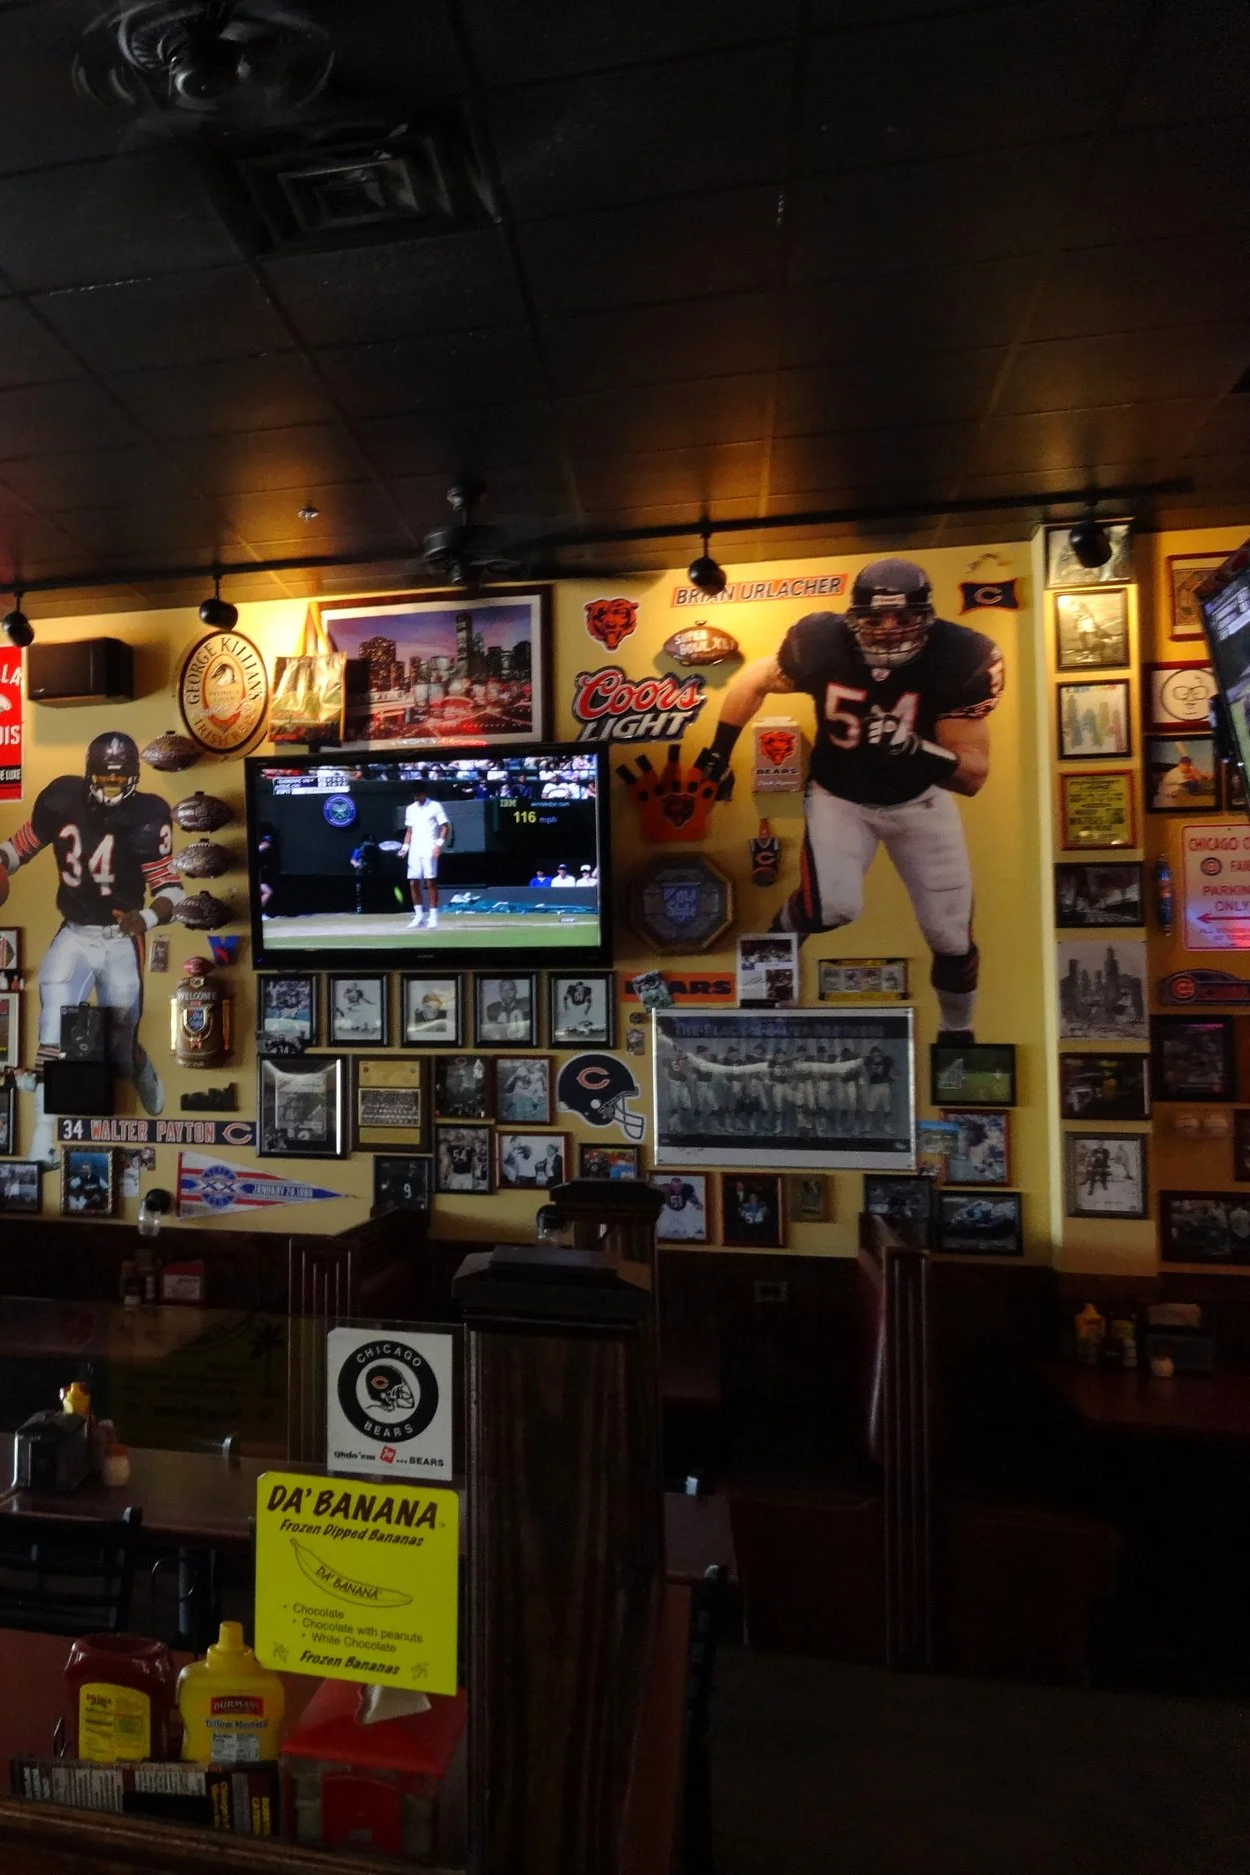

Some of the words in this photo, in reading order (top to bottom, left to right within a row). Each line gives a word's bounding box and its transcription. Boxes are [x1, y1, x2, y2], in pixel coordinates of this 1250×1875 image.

[740, 577, 842, 601] URLACHER
[186, 642, 218, 706] GEORGE
[575, 669, 702, 720] Coors
[194, 719, 228, 746] IRISH
[582, 709, 694, 741] LIGHT
[756, 767, 799, 775] BEARS
[499, 798, 518, 808] IBM
[513, 810, 537, 824] 116
[539, 815, 558, 825] mph
[1188, 837, 1239, 851] CHICAGO
[59, 823, 116, 897] 34
[177, 991, 217, 1001] WELCOME
[62, 1119, 85, 1141] 34
[90, 1120, 149, 1143] WALTER
[156, 1121, 217, 1144] PAYTON
[252, 1184, 282, 1197] JANUARY
[356, 1344, 422, 1368] CHICAGO
[363, 1420, 414, 1438] BEARS
[266, 1484, 313, 1514] DA'
[313, 1489, 439, 1530] BANANA
[279, 1519, 321, 1535] Frozen
[323, 1523, 366, 1541] Dipped
[368, 1528, 424, 1547] Bananas
[314, 1565, 335, 1583] DA'
[333, 1577, 380, 1600] BANANA
[292, 1602, 345, 1619] Chocolate
[301, 1617, 354, 1635] Chocolate
[357, 1625, 379, 1637] with
[380, 1629, 423, 1644] peanuts
[311, 1631, 341, 1646] White
[343, 1636, 397, 1653] Chocolate
[299, 1650, 343, 1668] Frozen
[344, 1656, 400, 1675] Bananas
